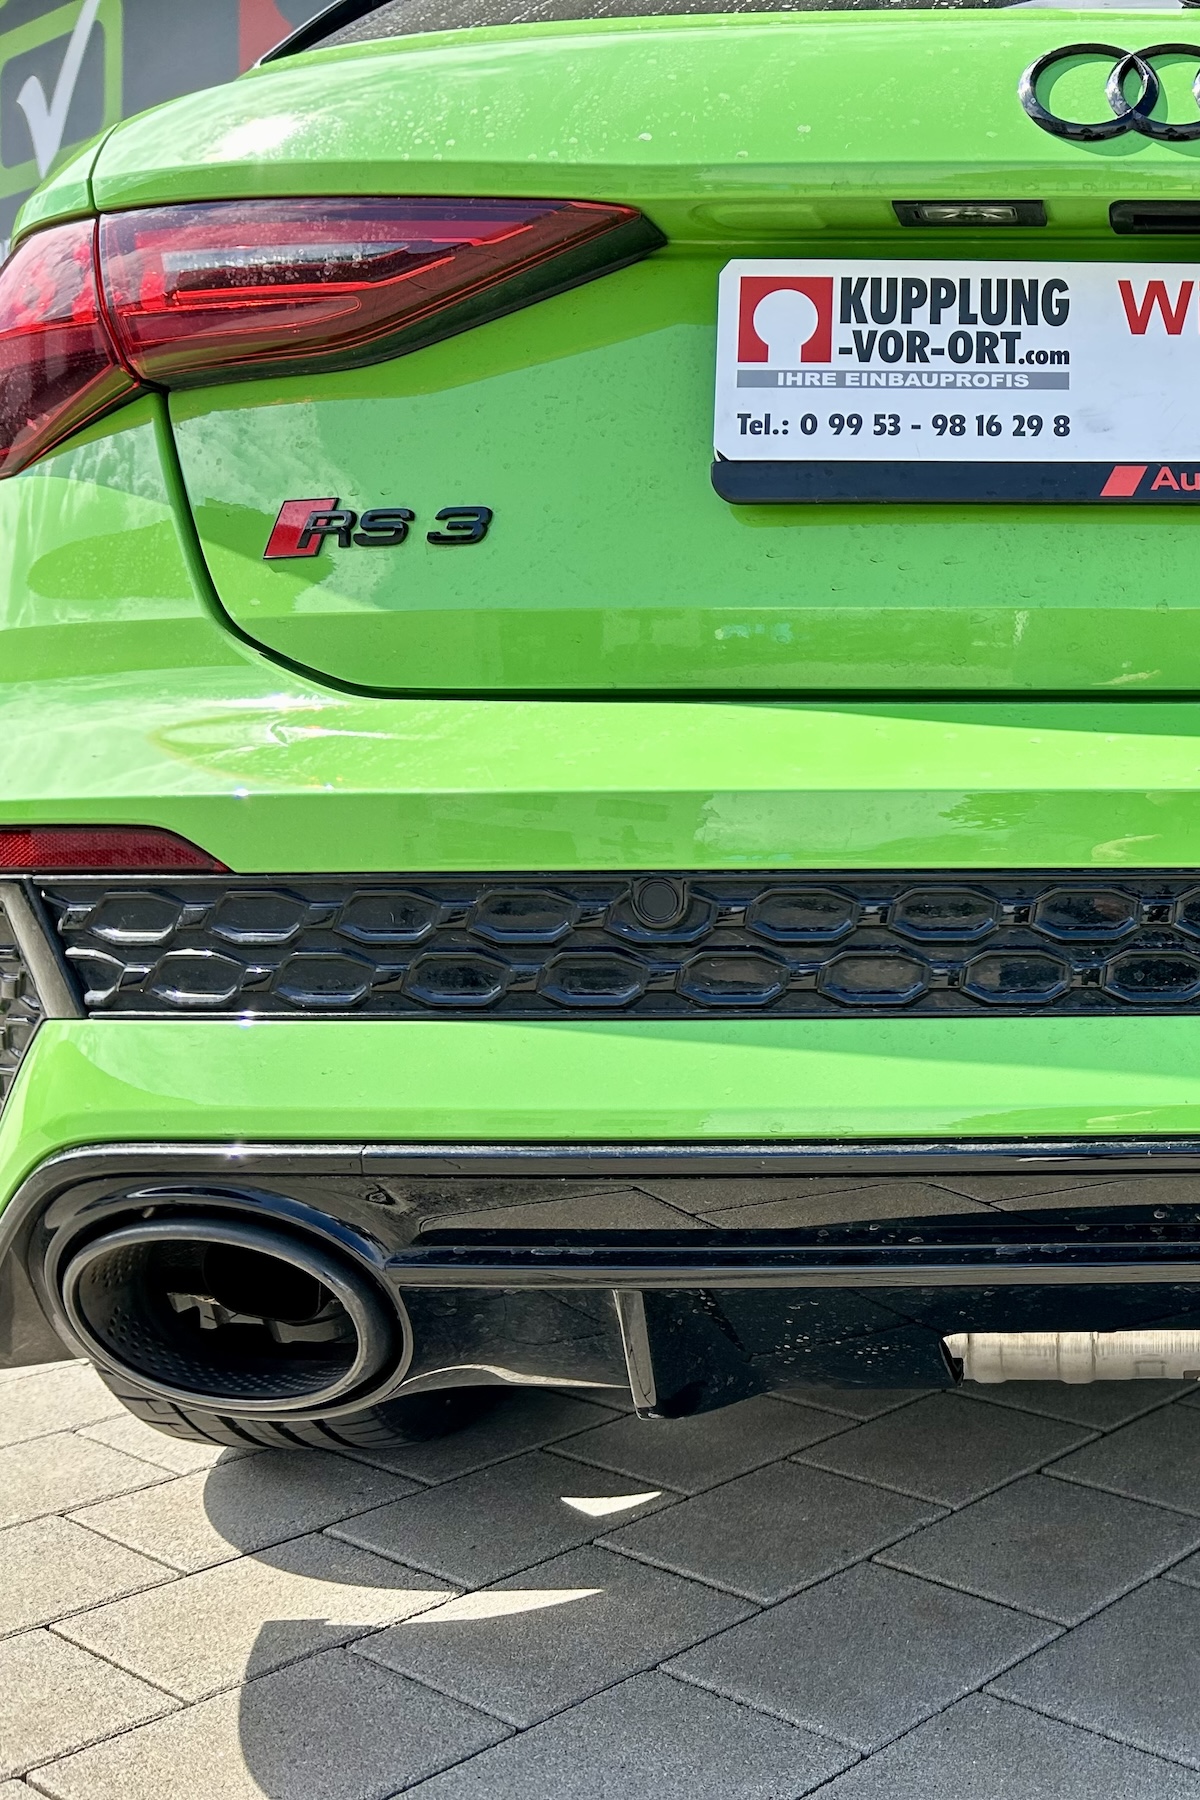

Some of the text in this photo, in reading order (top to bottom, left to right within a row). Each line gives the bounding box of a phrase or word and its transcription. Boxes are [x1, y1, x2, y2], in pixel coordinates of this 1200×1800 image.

[839, 276, 1070, 326] KUPPLUNG
[777, 371, 1030, 388] IHRE EINBAUPROFIS
[737, 413, 789, 436] Tel.:
[800, 413, 818, 435] 0
[828, 413, 863, 436] 99
[873, 414, 901, 436] 53
[931, 414, 966, 437] 98
[976, 415, 1003, 437] 16
[1012, 415, 1044, 437] 29
[1053, 416, 1071, 437] 8
[296, 506, 494, 549] RS 3
